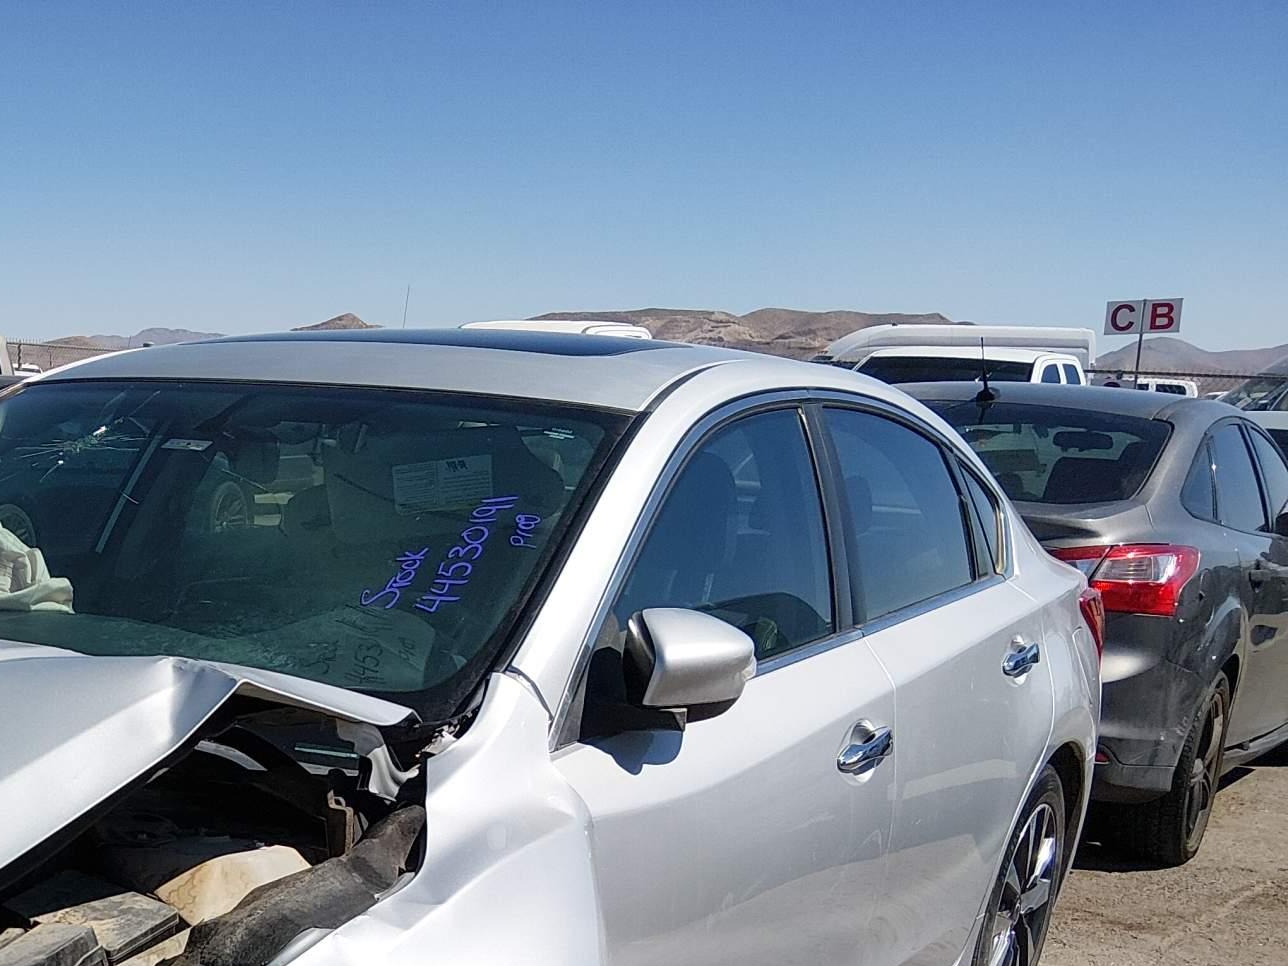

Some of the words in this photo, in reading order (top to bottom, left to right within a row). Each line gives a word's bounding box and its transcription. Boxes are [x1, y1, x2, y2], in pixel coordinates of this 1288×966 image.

[1110, 303, 1136, 332] C
[1149, 302, 1175, 331] B
[414, 495, 520, 614] 44530191
